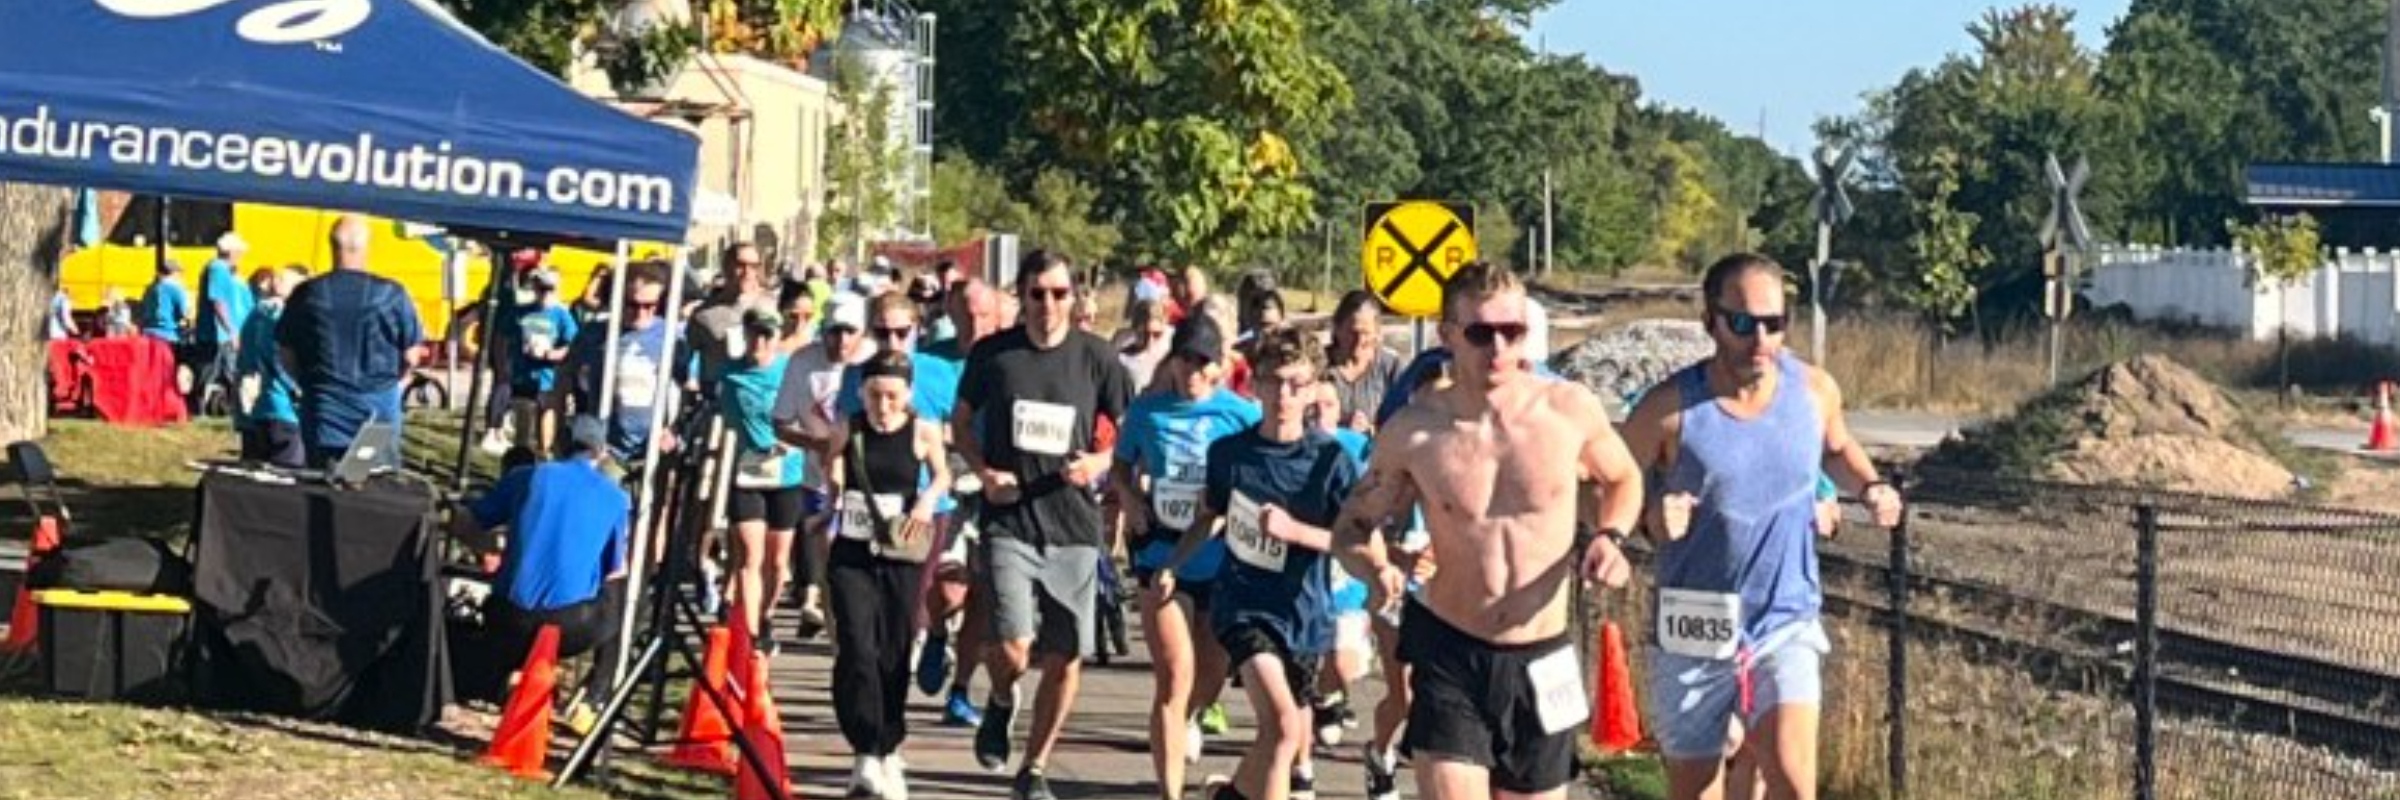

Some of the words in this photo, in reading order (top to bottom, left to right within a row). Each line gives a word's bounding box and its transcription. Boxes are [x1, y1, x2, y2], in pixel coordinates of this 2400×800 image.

[0, 104, 673, 214] duranceevolution.com
[1376, 246, 1397, 271] R
[1445, 246, 1465, 271] R
[1161, 499, 1197, 519] 107
[1666, 614, 1733, 642] 10835
